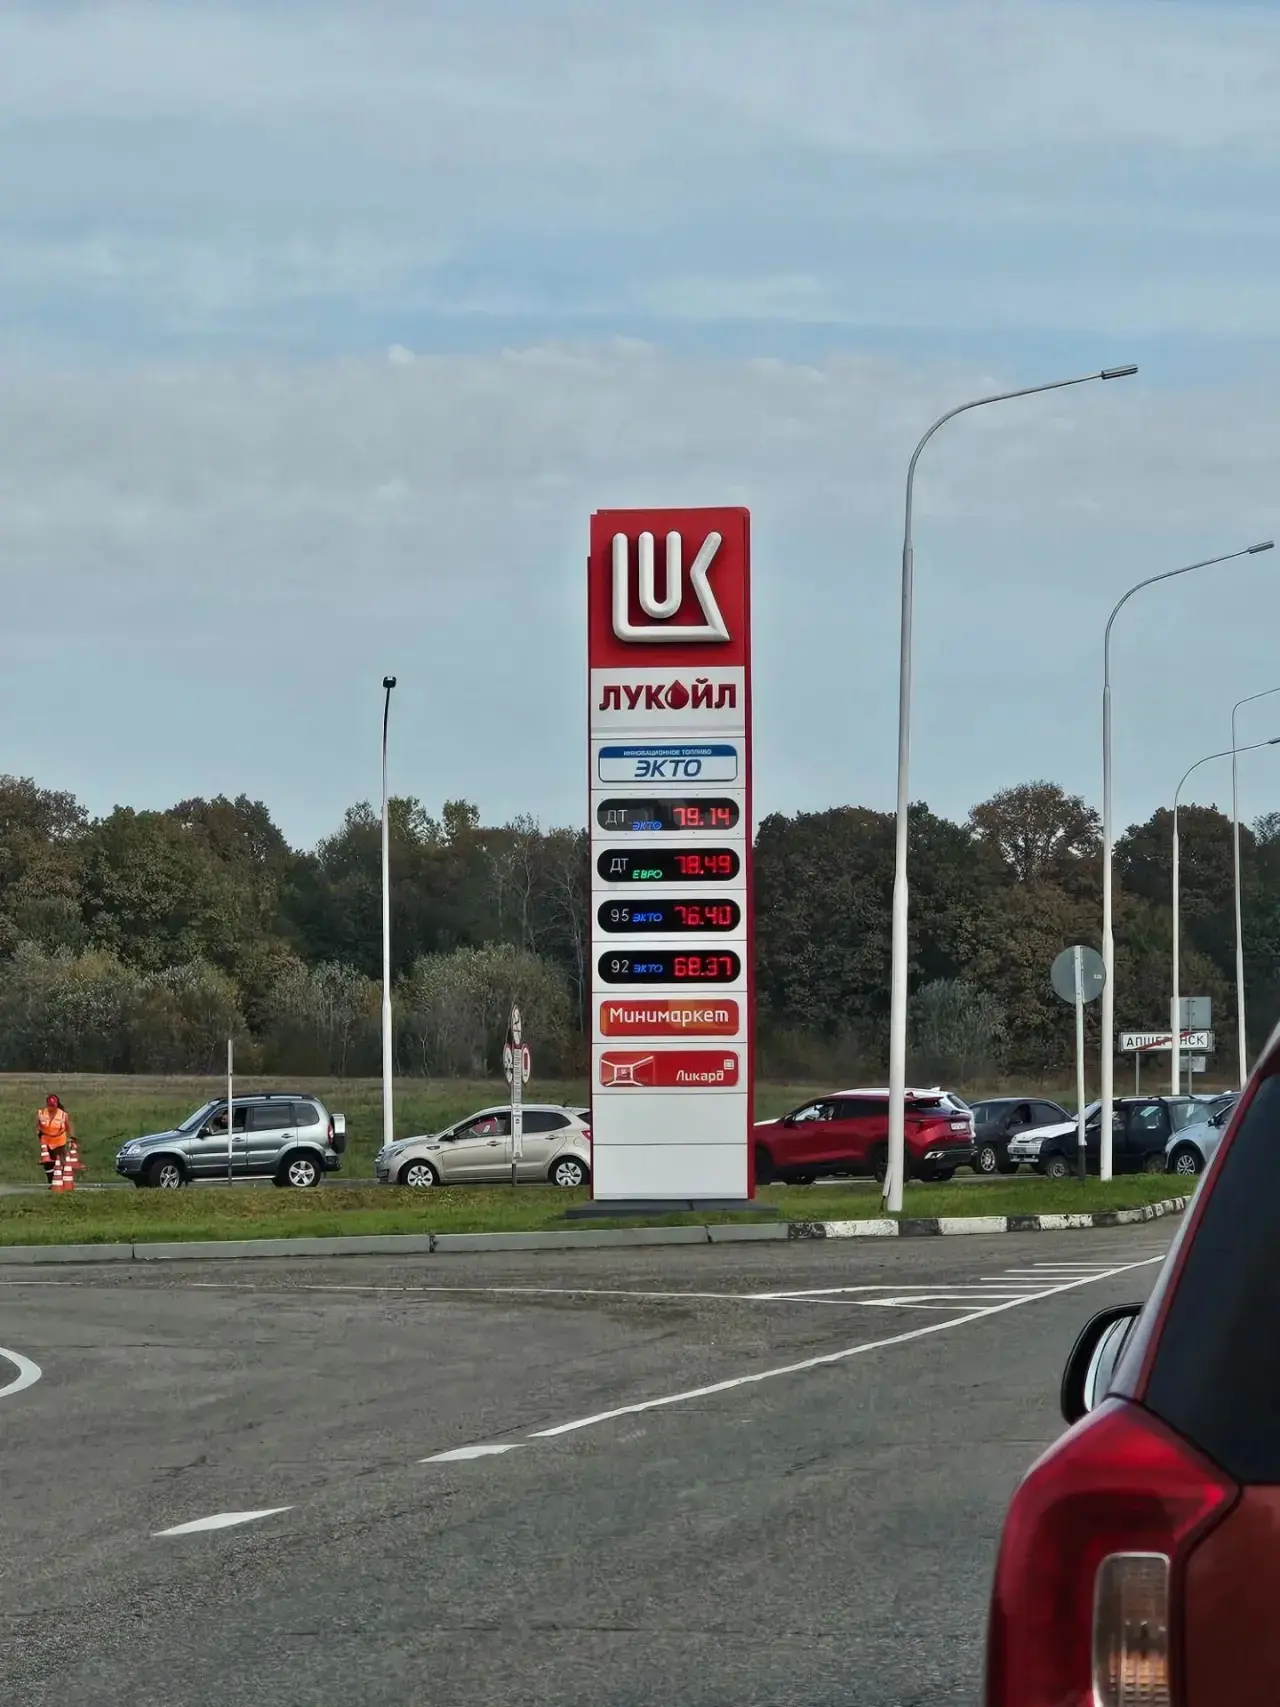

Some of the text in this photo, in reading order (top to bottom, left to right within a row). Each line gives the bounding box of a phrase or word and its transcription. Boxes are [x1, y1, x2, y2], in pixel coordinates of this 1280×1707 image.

[599, 678, 737, 711] ЛУКОЙЛ
[634, 758, 702, 778] ЭКТО
[605, 809, 628, 825] ДТ
[632, 821, 662, 831] ЭКТО
[610, 858, 629, 873] ДТ
[674, 856, 732, 874] 78.49
[632, 869, 663, 879] ЕВРО
[610, 905, 733, 925] 95 ЭКТО 76.40
[611, 957, 732, 977] 92 ЭКТО 68.37
[609, 1007, 729, 1027] Минимаркет
[1126, 1035, 1205, 1047] АПШЕРНСК
[676, 1070, 725, 1083] Ликард
